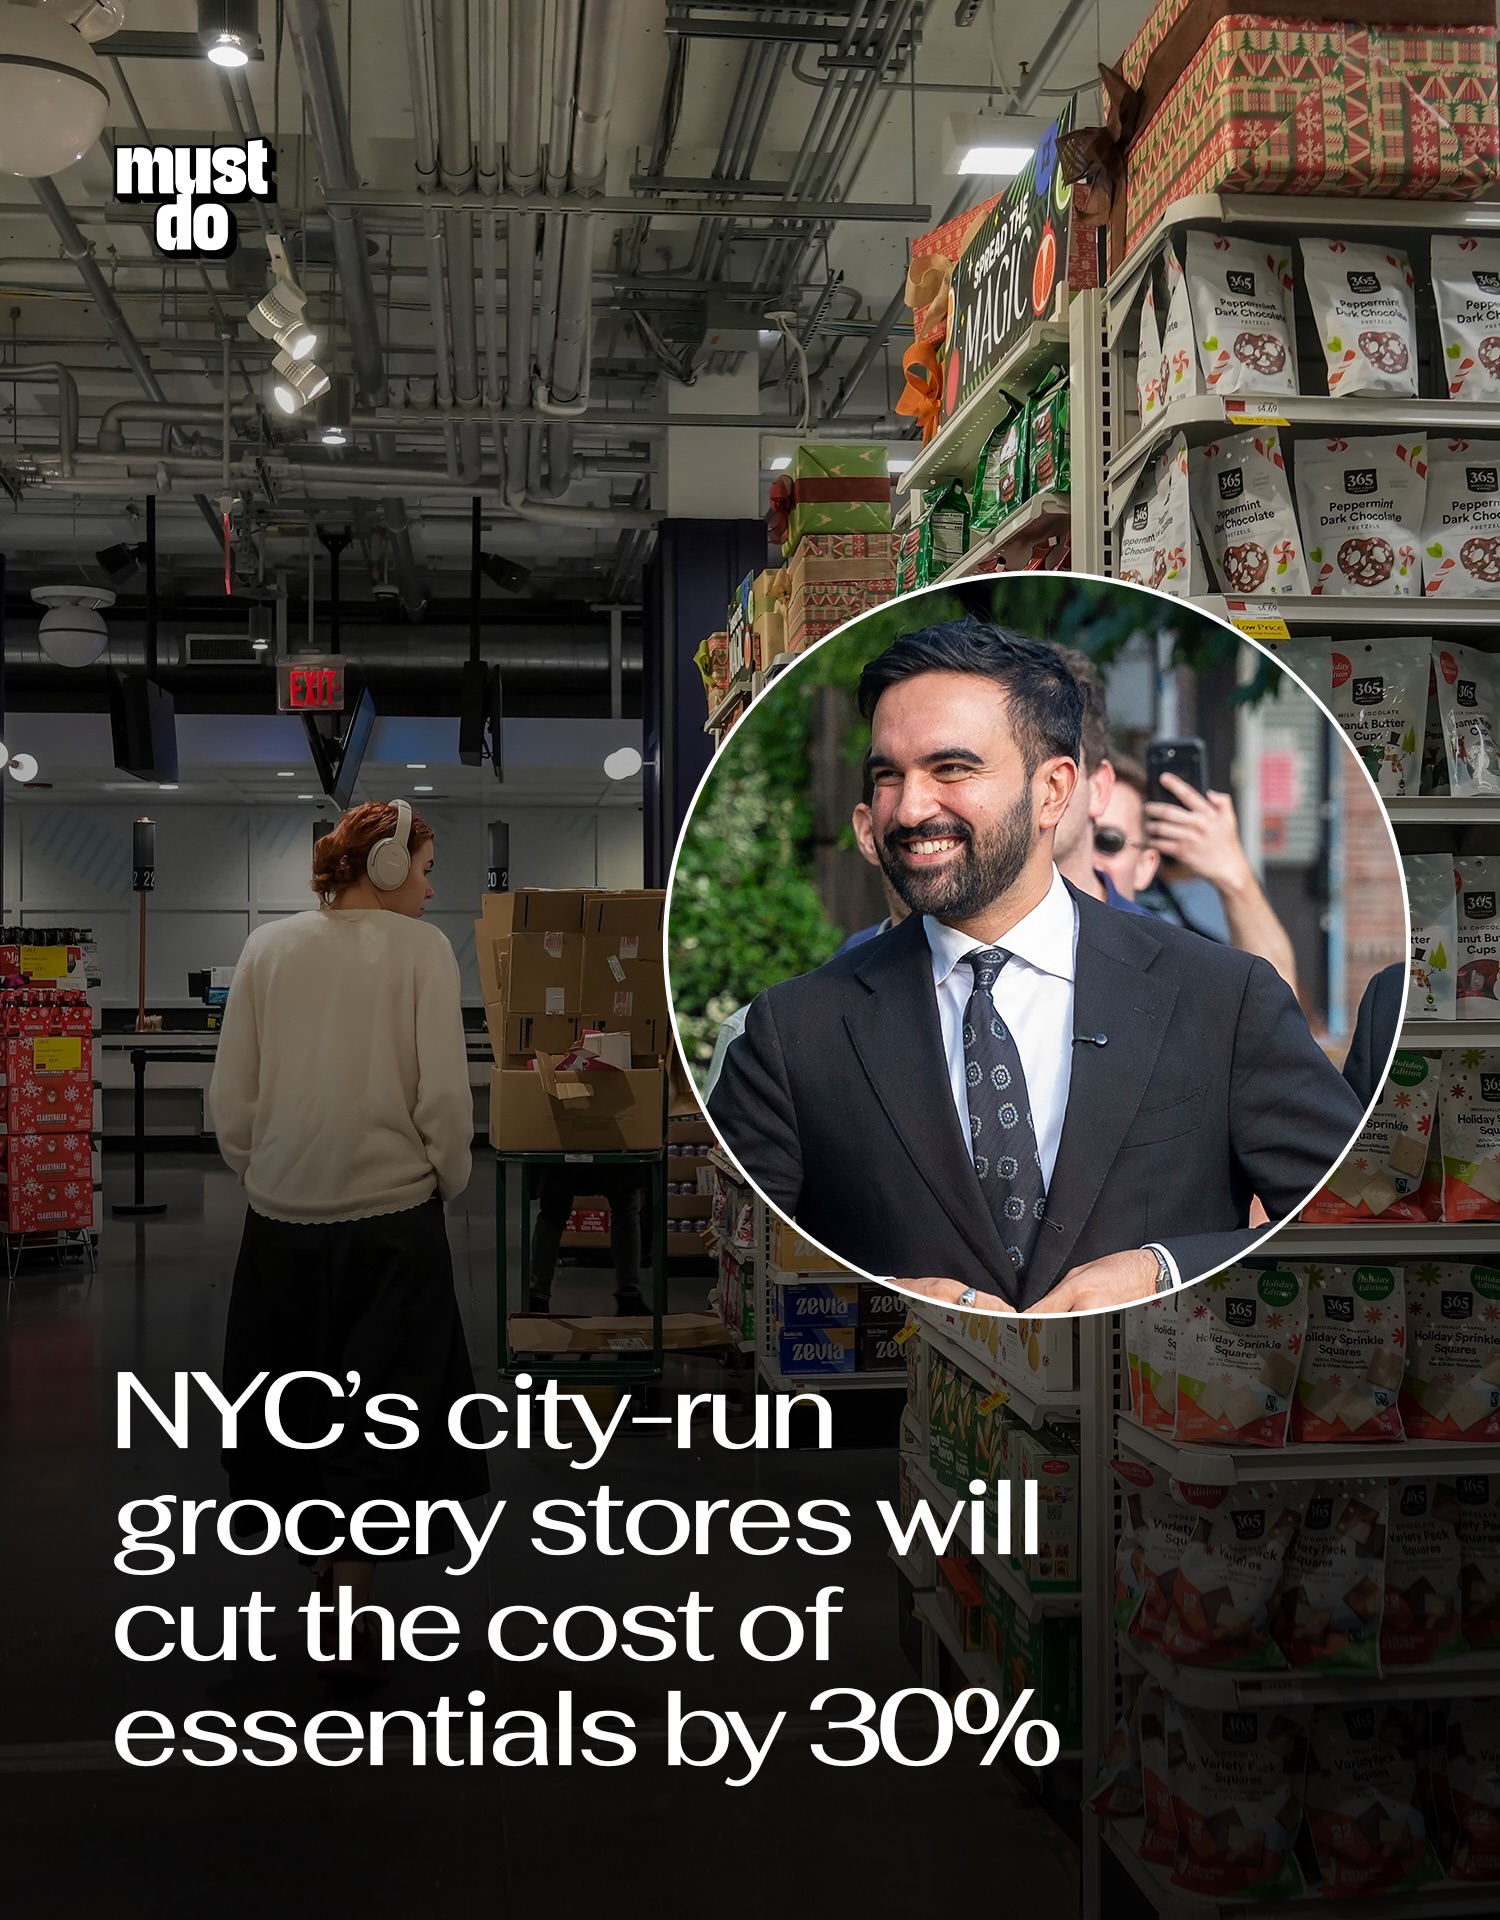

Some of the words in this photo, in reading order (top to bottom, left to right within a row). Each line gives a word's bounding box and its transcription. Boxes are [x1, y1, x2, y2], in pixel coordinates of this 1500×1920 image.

[973, 222, 1008, 289] SPREAD
[1009, 191, 1029, 240] THE
[1230, 275, 1252, 290] 365
[1350, 276, 1376, 286] 365
[963, 226, 1032, 385] MAGIC
[1220, 298, 1277, 311] Peppermint
[1215, 307, 1239, 317] Dark
[1240, 308, 1287, 321] Chocolate
[1457, 313, 1484, 324] Dark
[1221, 473, 1241, 491] 365
[1347, 472, 1374, 487] 365
[1470, 471, 1495, 486] 365
[1329, 498, 1394, 512] Peppermint
[1225, 510, 1275, 529] Chocolate
[1320, 514, 1347, 526] Dark
[1350, 511, 1402, 523] Chocolate
[1443, 513, 1469, 524] Dark
[290, 671, 337, 707] EXIT
[1356, 681, 1381, 696] 365
[1458, 684, 1474, 699] 365
[1371, 719, 1406, 729] Butter
[1467, 896, 1493, 909] 365
[1467, 945, 1497, 955] Cups
[1392, 1067, 1422, 1077] Edition
[1366, 1118, 1409, 1132] Sprinkle
[1457, 1114, 1495, 1125] Holiday
[1262, 1279, 1295, 1290] Holiday
[1357, 1272, 1390, 1284] Holiday
[1358, 1283, 1389, 1292] Edition
[796, 1297, 848, 1315] zevia
[1327, 1299, 1351, 1314] 365
[1443, 1296, 1470, 1309] 365
[1228, 1302, 1253, 1318] 365
[1196, 1333, 1235, 1347] Holiday
[1237, 1338, 1282, 1350] Sprinkle
[1339, 1334, 1384, 1346] Sprinkle
[1414, 1331, 1453, 1343] Holiday
[1455, 1332, 1500, 1345] Sprinkle
[792, 1343, 845, 1361] zevia
[1214, 1345, 1257, 1359] Squares
[1318, 1344, 1362, 1356] Squares
[1434, 1343, 1477, 1355] Squares
[1187, 1486, 1222, 1496] Edition
[1460, 1479, 1485, 1495] 365
[1403, 1490, 1425, 1505] 365
[1307, 1503, 1330, 1519] 365
[1235, 1513, 1261, 1530] 365
[1396, 1522, 1435, 1530] CHOCOLATE
[1388, 1531, 1421, 1543] Variety
[1423, 1529, 1450, 1541] Pack
[1321, 1545, 1347, 1556] Pack
[1402, 1545, 1441, 1557] Squares
[1288, 1551, 1333, 1567] Squares
[1225, 1716, 1254, 1733] 365
[1200, 1755, 1244, 1772] Variety
[1334, 1756, 1372, 1771] Variety
[1372, 1752, 1395, 1764] Pack
[1215, 1771, 1263, 1786] Squares
[1352, 1768, 1390, 1782] Squares
[1468, 1809, 1490, 1824] 22
[1331, 1823, 1354, 1840] 22
